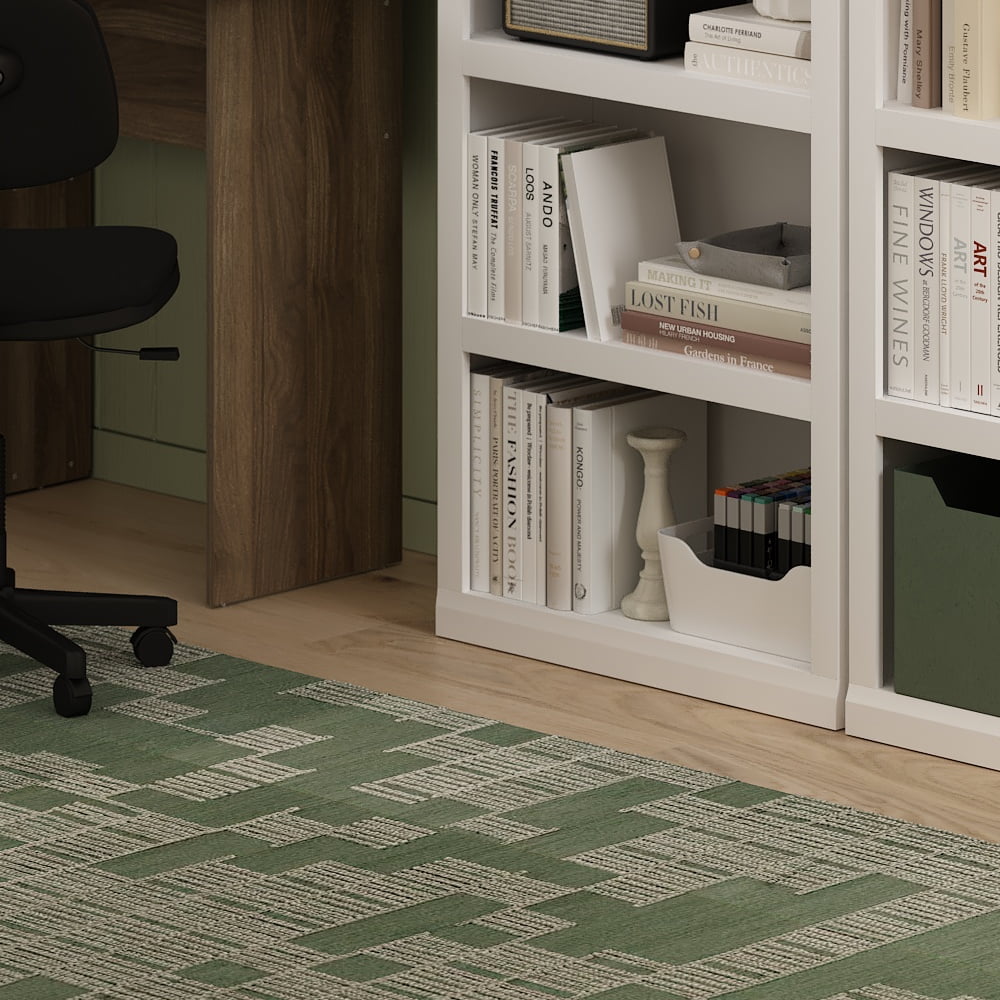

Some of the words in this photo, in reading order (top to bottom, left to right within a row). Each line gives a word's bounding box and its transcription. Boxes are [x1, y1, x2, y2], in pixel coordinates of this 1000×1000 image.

[702, 24, 734, 35] CHARLOTTE
[734, 28, 762, 39] PERRIAND
[915, 30, 923, 56] Mary
[962, 23, 970, 64] Gustave
[901, 43, 909, 84] Pomiane
[915, 60, 923, 99] Shelley
[962, 68, 970, 111] Flaubert
[490, 150, 498, 190] FRANCOIS
[525, 168, 534, 201] LOOS
[490, 194, 498, 229] TRUFFAT
[542, 181, 553, 228] ANDO
[490, 232, 498, 245] The
[892, 204, 909, 265] FINE
[919, 186, 934, 277] WINDOWS
[490, 247, 498, 281] Complete
[953, 237, 967, 274] ART
[973, 240, 987, 278] ART
[490, 283, 498, 302] Films
[647, 269, 696, 288] MAKING
[700, 280, 712, 291] IT
[631, 289, 675, 313] LOST
[680, 299, 719, 322] FISH
[892, 279, 909, 368] WINES
[659, 321, 676, 331] NEW
[677, 325, 702, 337] URBAN
[703, 330, 736, 343] HOUSING
[678, 333, 700, 342] FRENCH
[684, 345, 725, 362] Gardens
[727, 353, 737, 365] in
[740, 356, 774, 373] France
[507, 391, 517, 434] THE
[472, 389, 482, 498] SIMPLICITY
[507, 439, 517, 529] FASHION
[507, 536, 517, 595] BOOK
